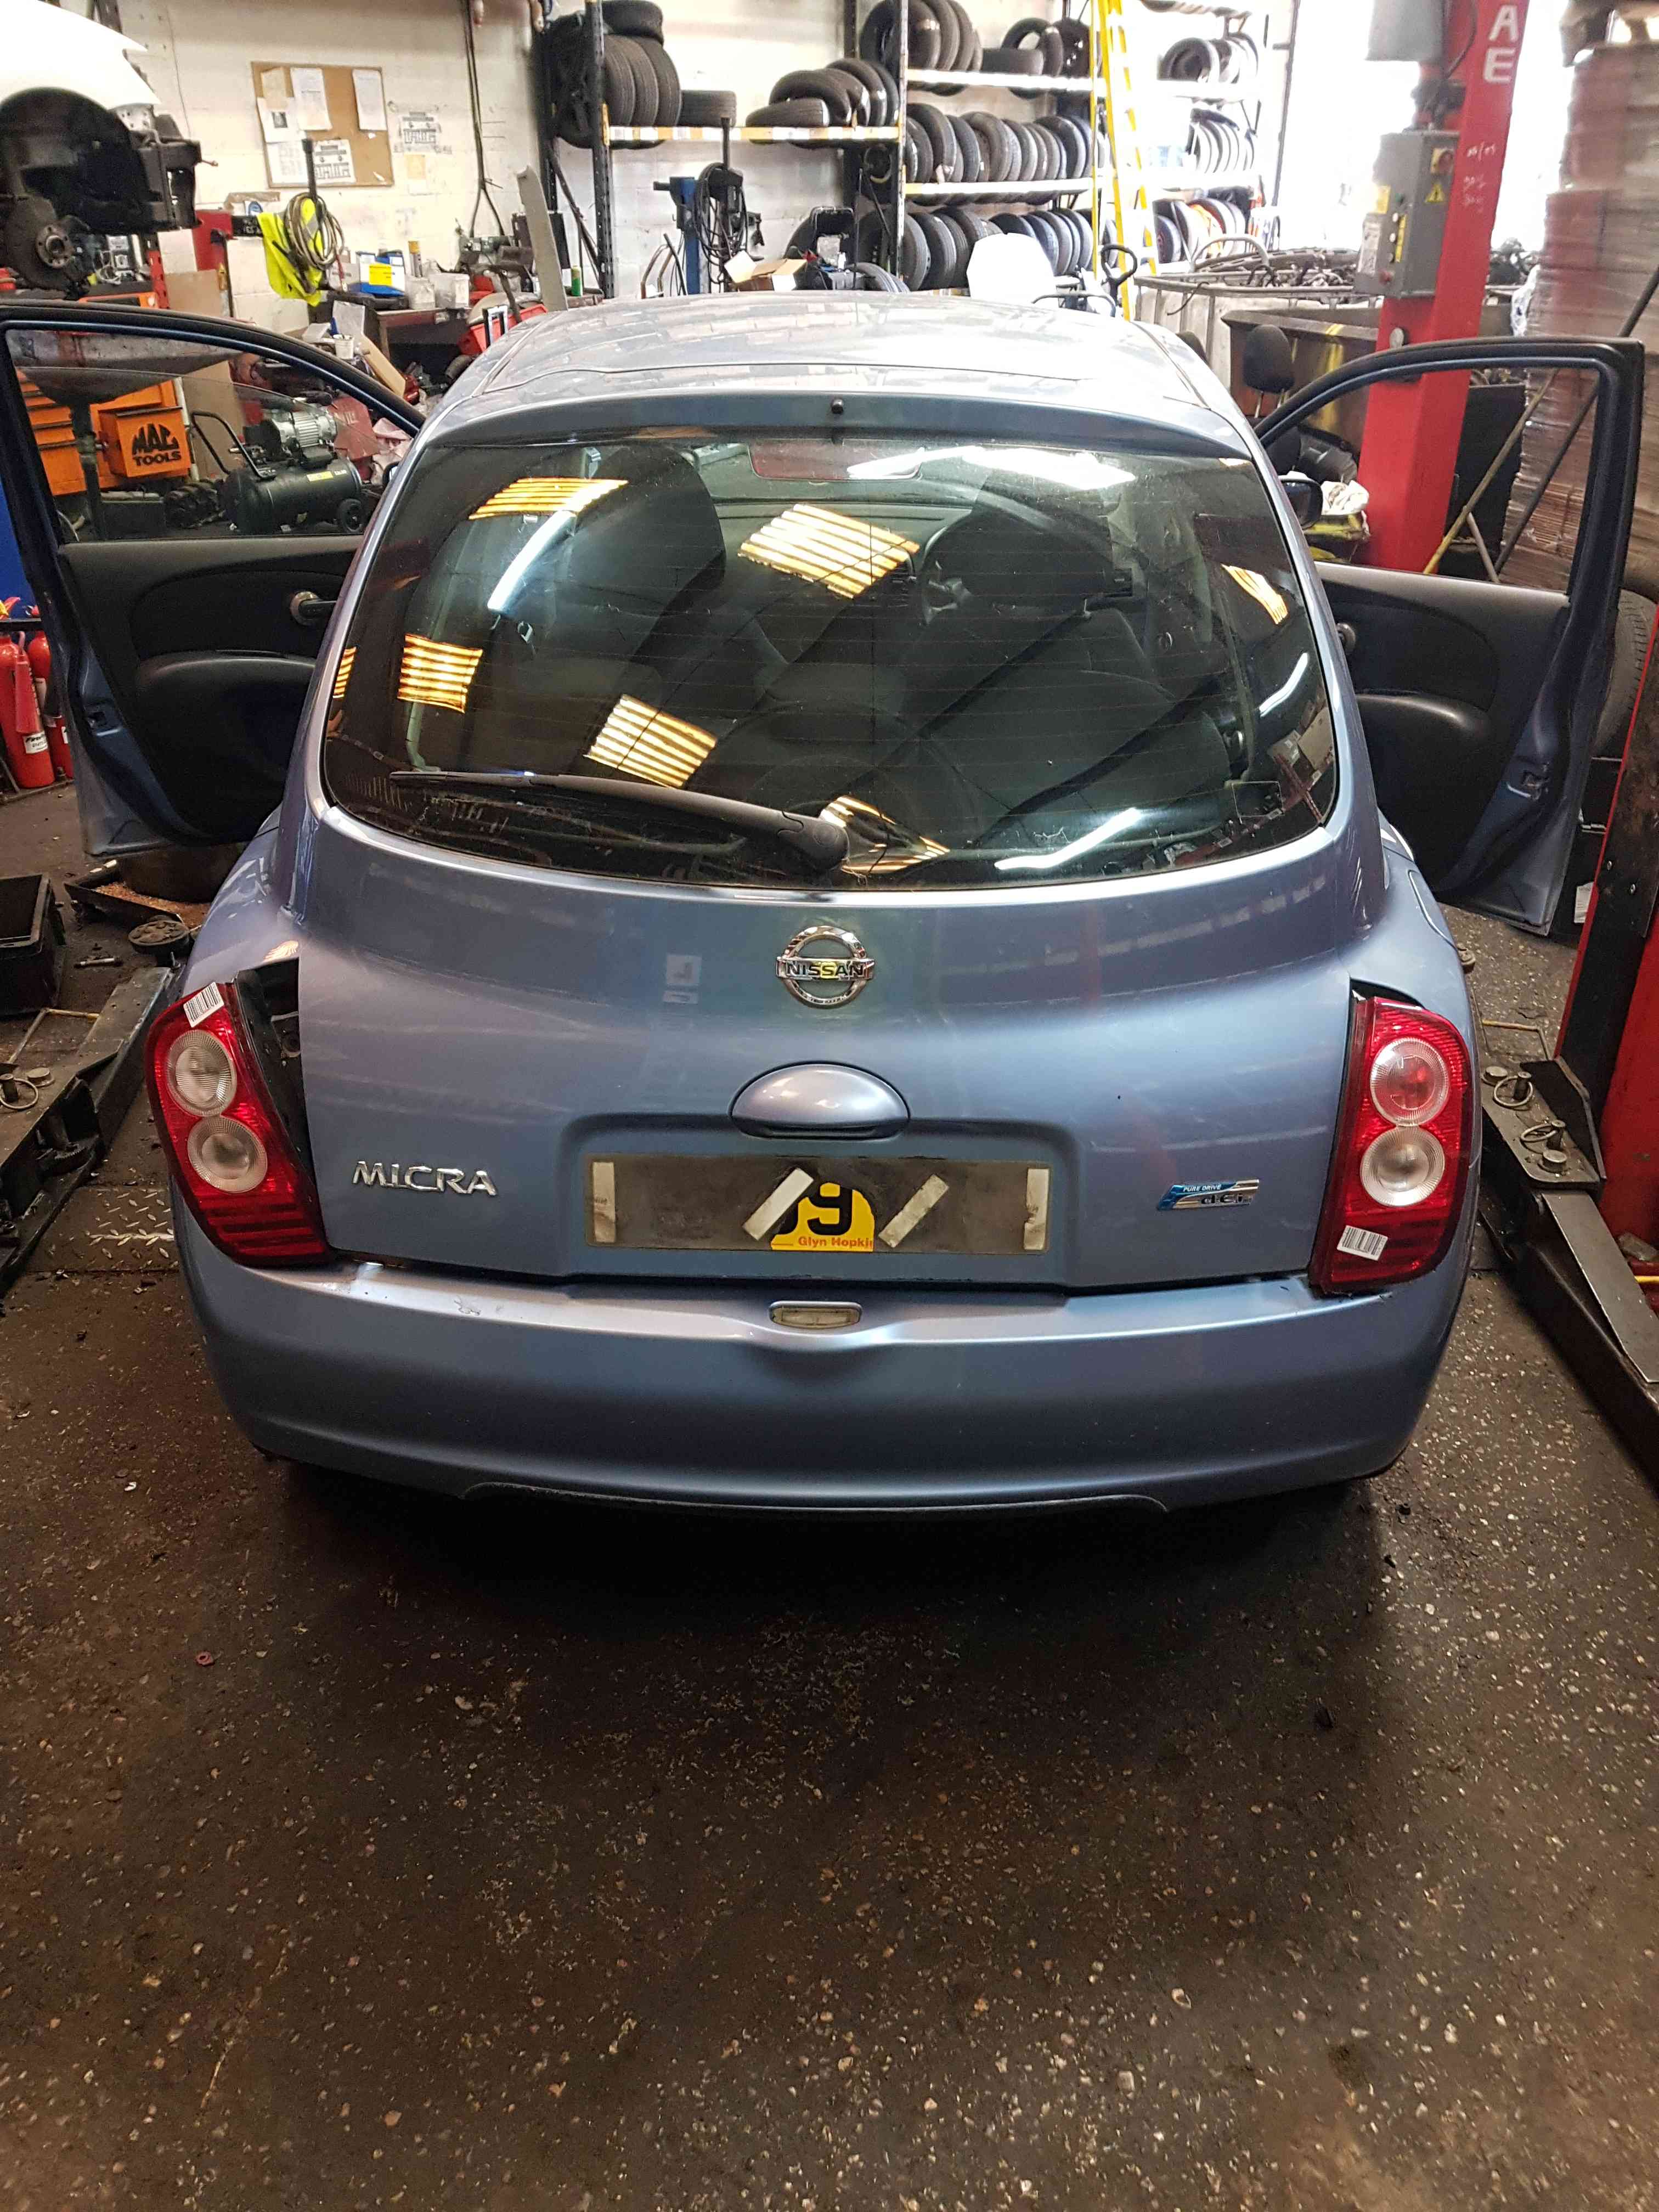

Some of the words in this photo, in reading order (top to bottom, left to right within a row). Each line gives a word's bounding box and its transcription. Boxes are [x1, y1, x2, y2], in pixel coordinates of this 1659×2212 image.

[132, 423, 179, 455] MAC
[132, 451, 181, 466] TOOLS
[787, 962, 864, 976] NISSAN
[352, 1160, 497, 1196] MICRA
[798, 1236, 827, 1248] Glyn
